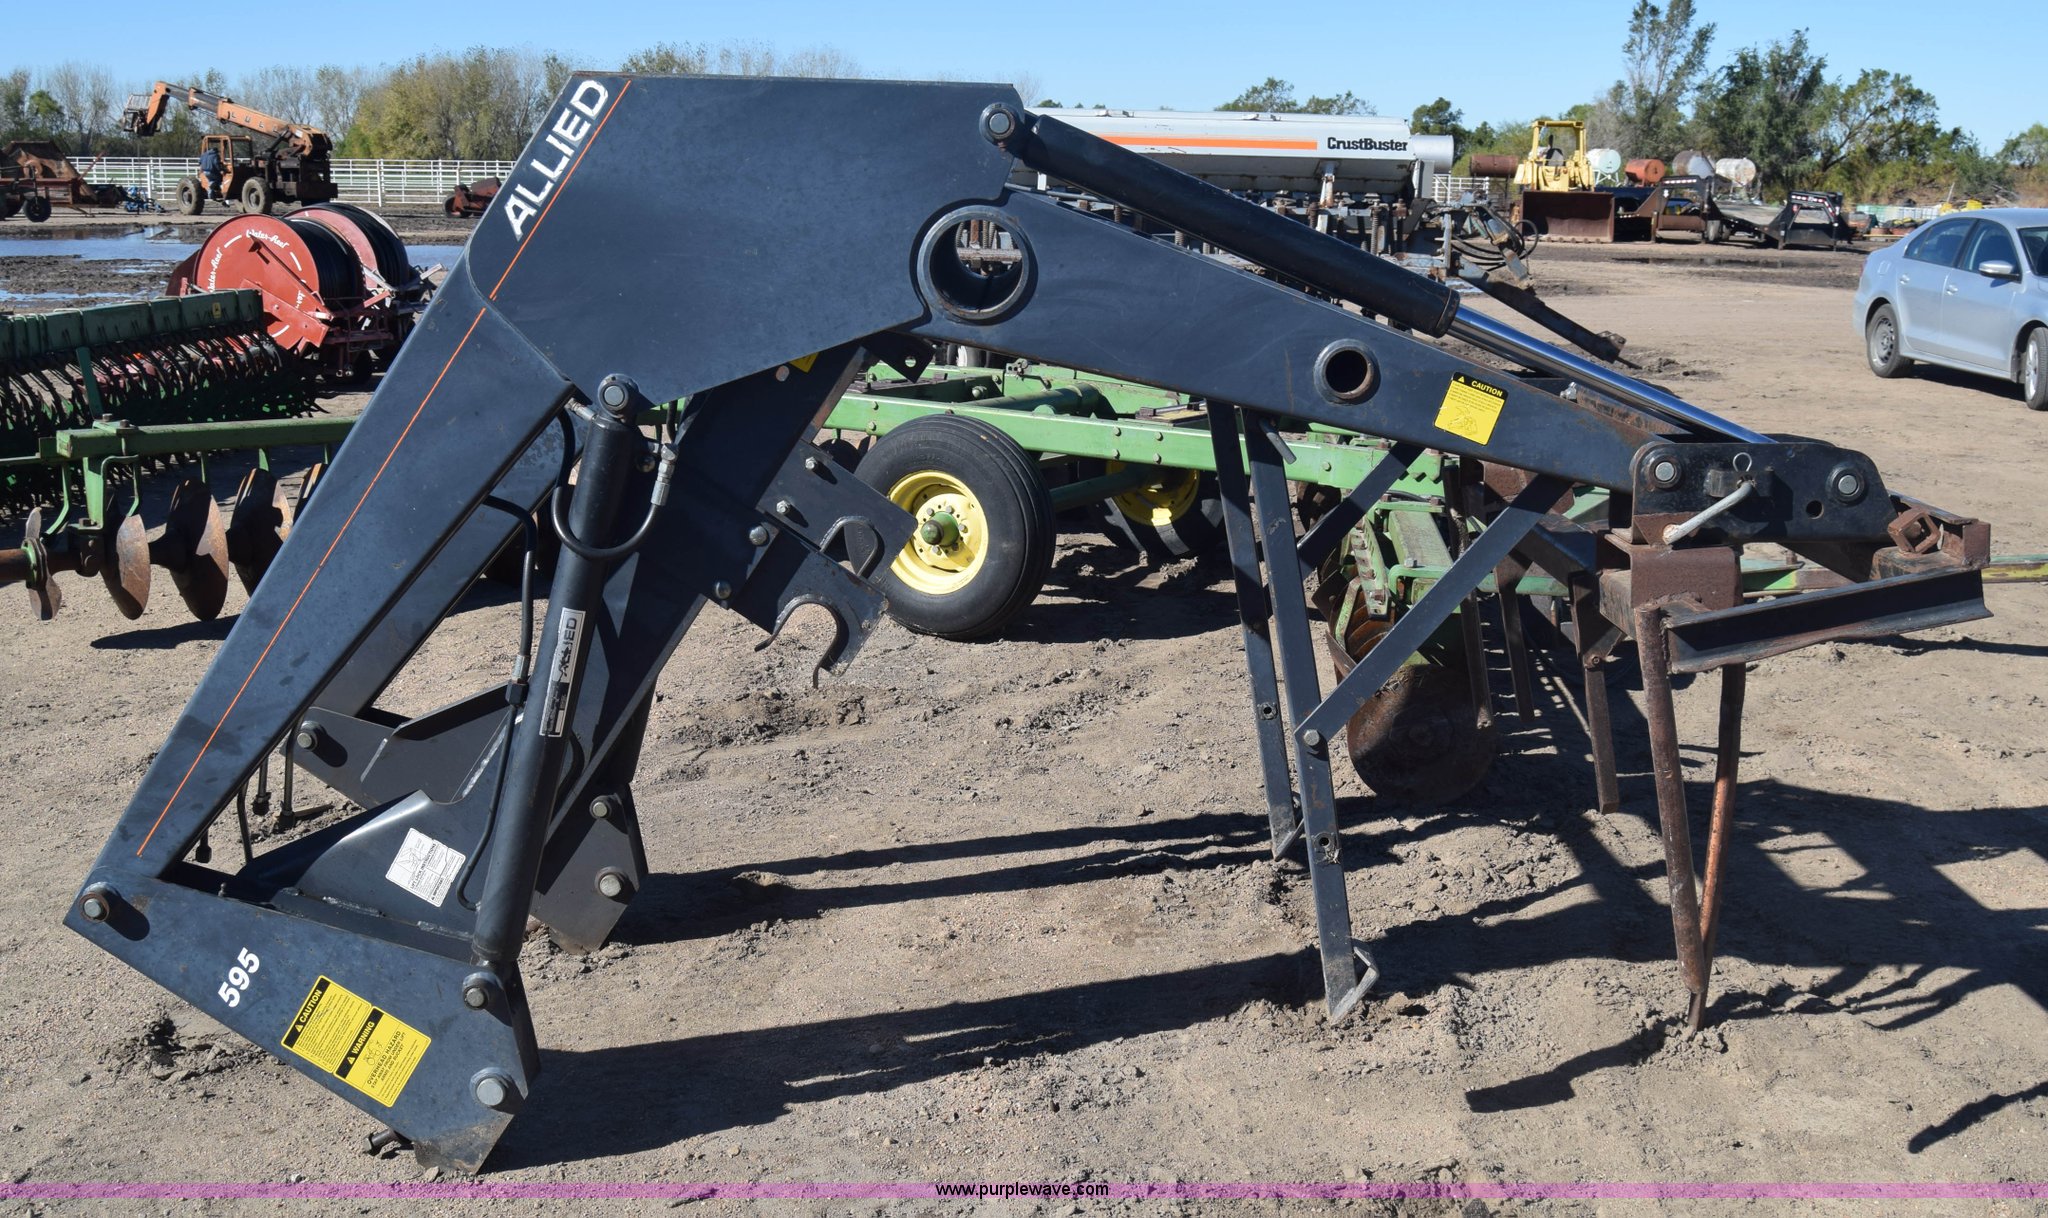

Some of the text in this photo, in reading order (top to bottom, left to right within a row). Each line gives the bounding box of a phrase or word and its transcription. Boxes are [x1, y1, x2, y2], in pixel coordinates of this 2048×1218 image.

[504, 79, 609, 242] ALLIED
[1327, 136, 1408, 152] CrustBuster
[1471, 380, 1503, 397] CAUTION
[218, 947, 260, 1007] 595
[299, 989, 322, 1023] CAUTION
[352, 1021, 375, 1055] WARNING
[367, 1031, 401, 1085] OVERHEAD HAZARD
